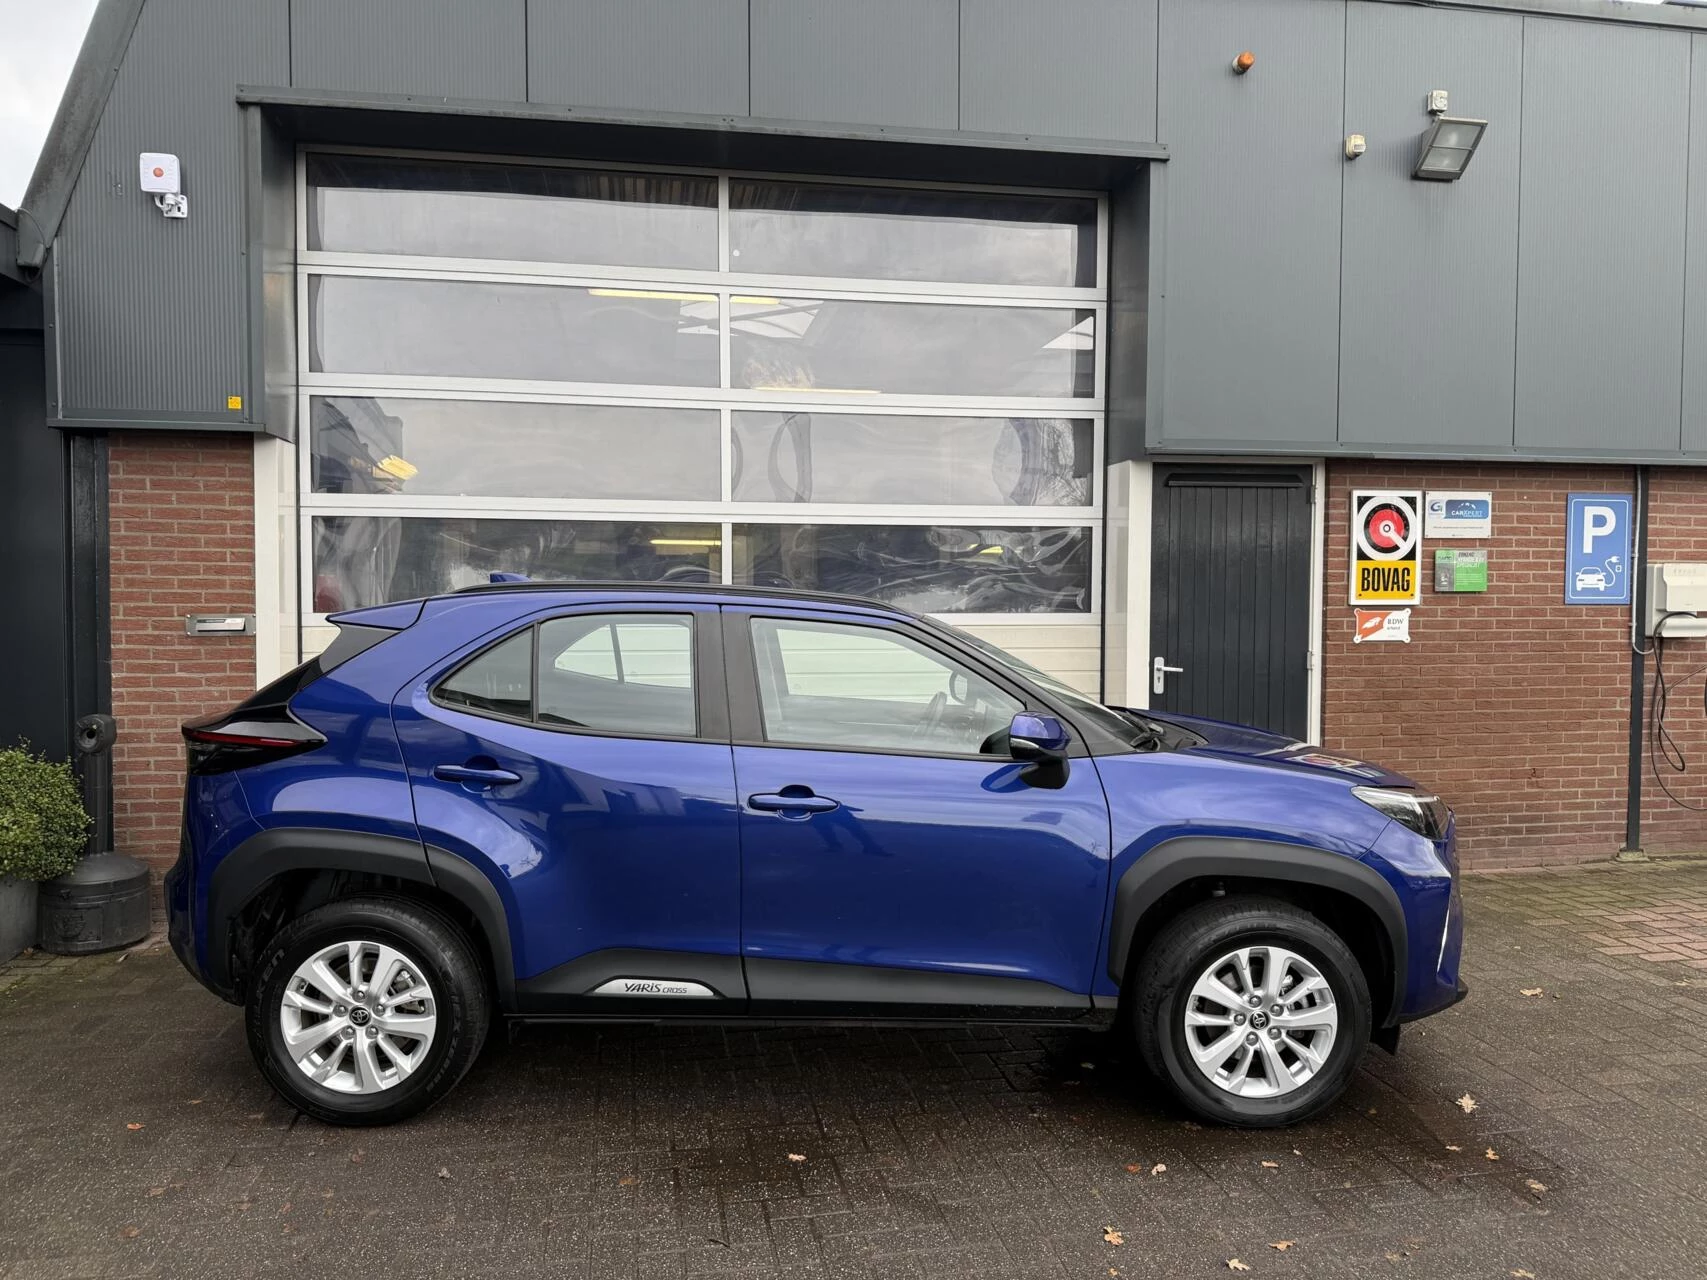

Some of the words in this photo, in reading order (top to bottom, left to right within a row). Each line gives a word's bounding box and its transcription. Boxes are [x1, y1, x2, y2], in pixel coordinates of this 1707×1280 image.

[1583, 506, 1616, 554] P
[1361, 567, 1411, 592] BOVAG
[662, 986, 688, 994] CROSS
